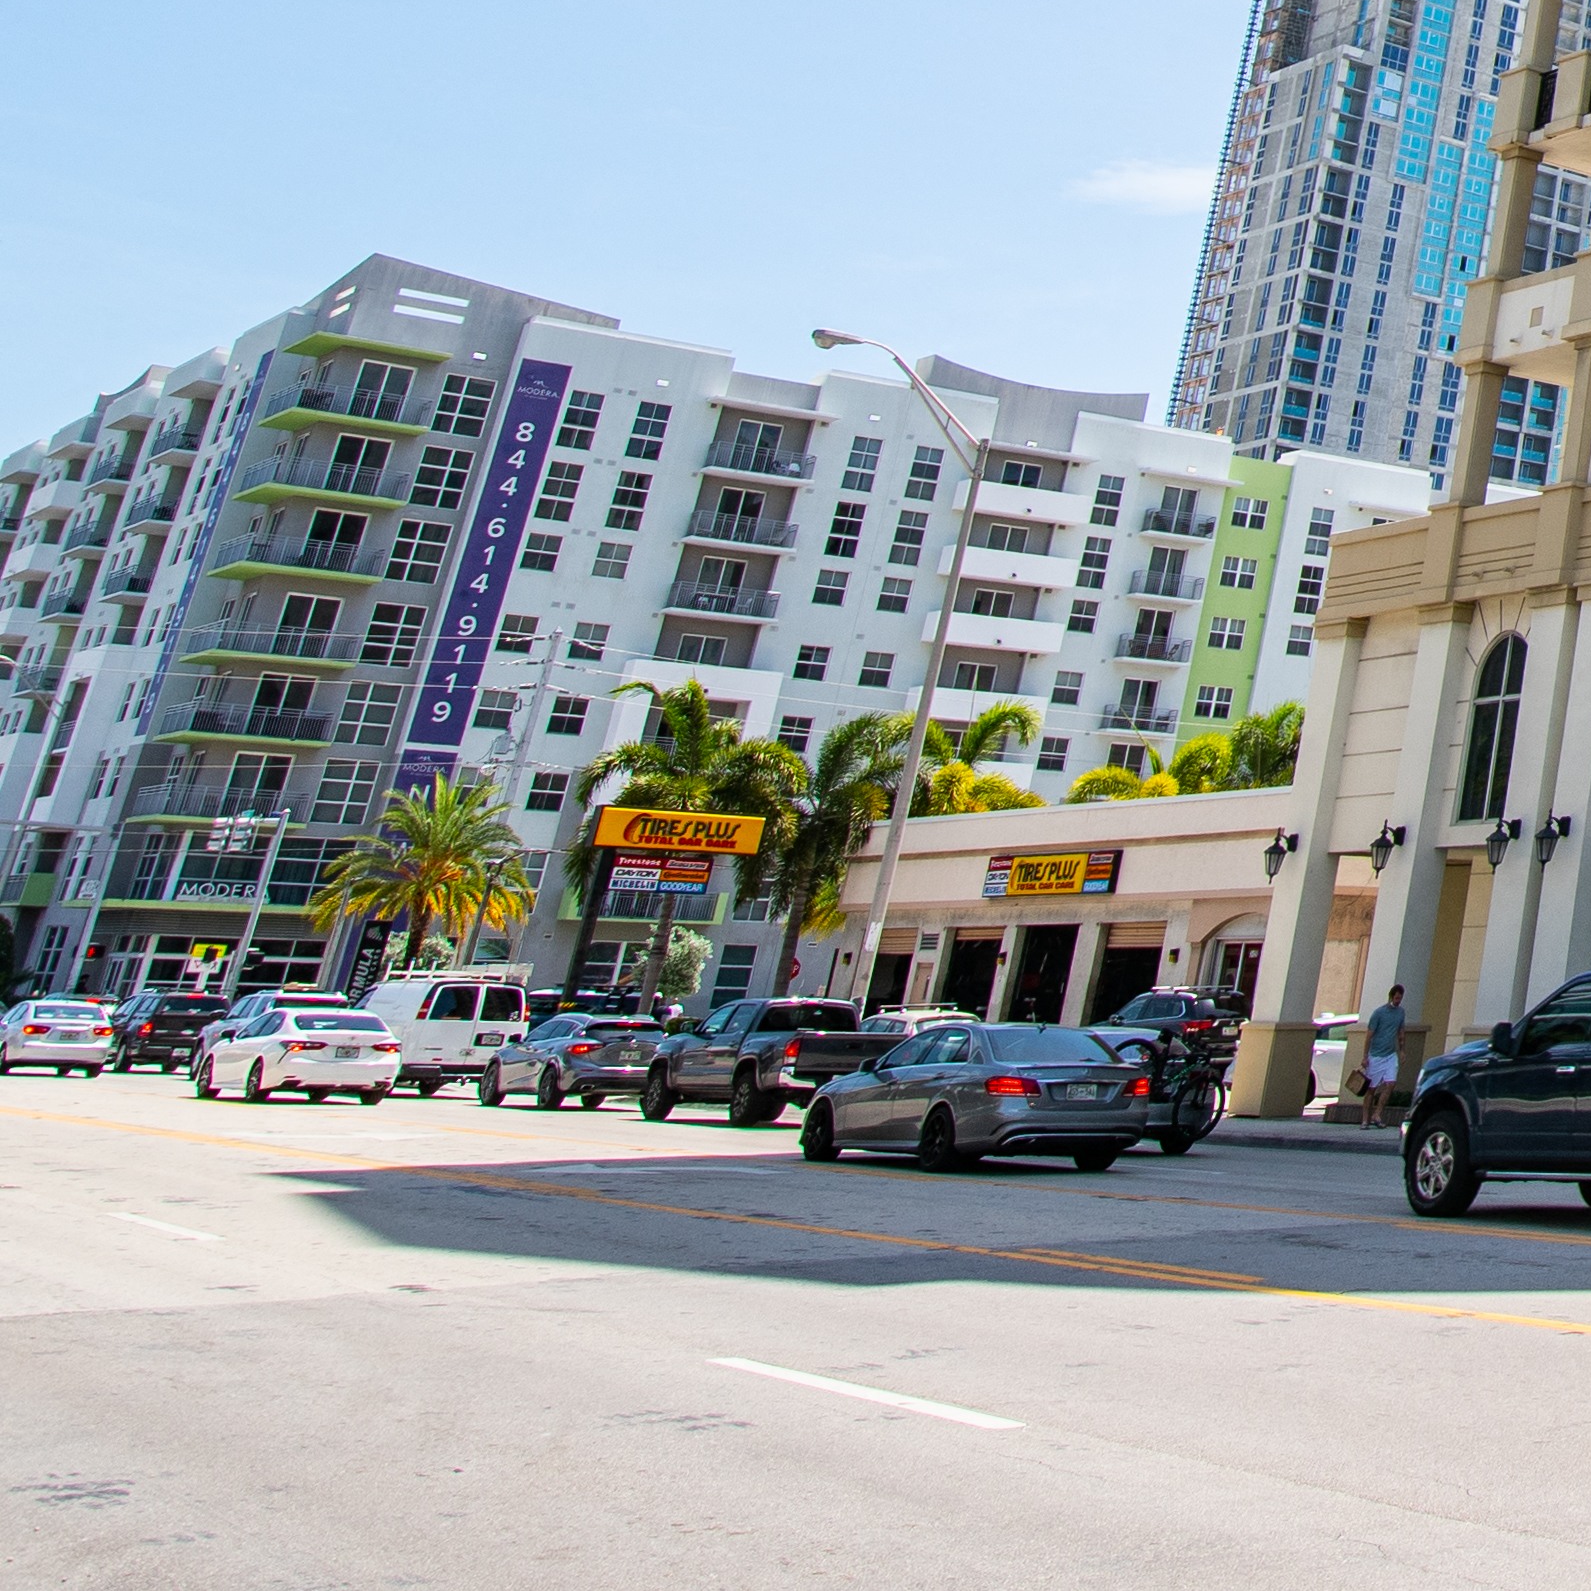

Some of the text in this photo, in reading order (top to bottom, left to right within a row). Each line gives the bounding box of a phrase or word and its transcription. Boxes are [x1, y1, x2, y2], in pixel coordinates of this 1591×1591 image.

[517, 386, 559, 398] MODERA
[638, 835, 738, 849] TOTAL CAR CARE
[614, 869, 658, 878] DAYTON
[611, 879, 658, 890] MICHELIN
[659, 881, 703, 892] GOODYEAR
